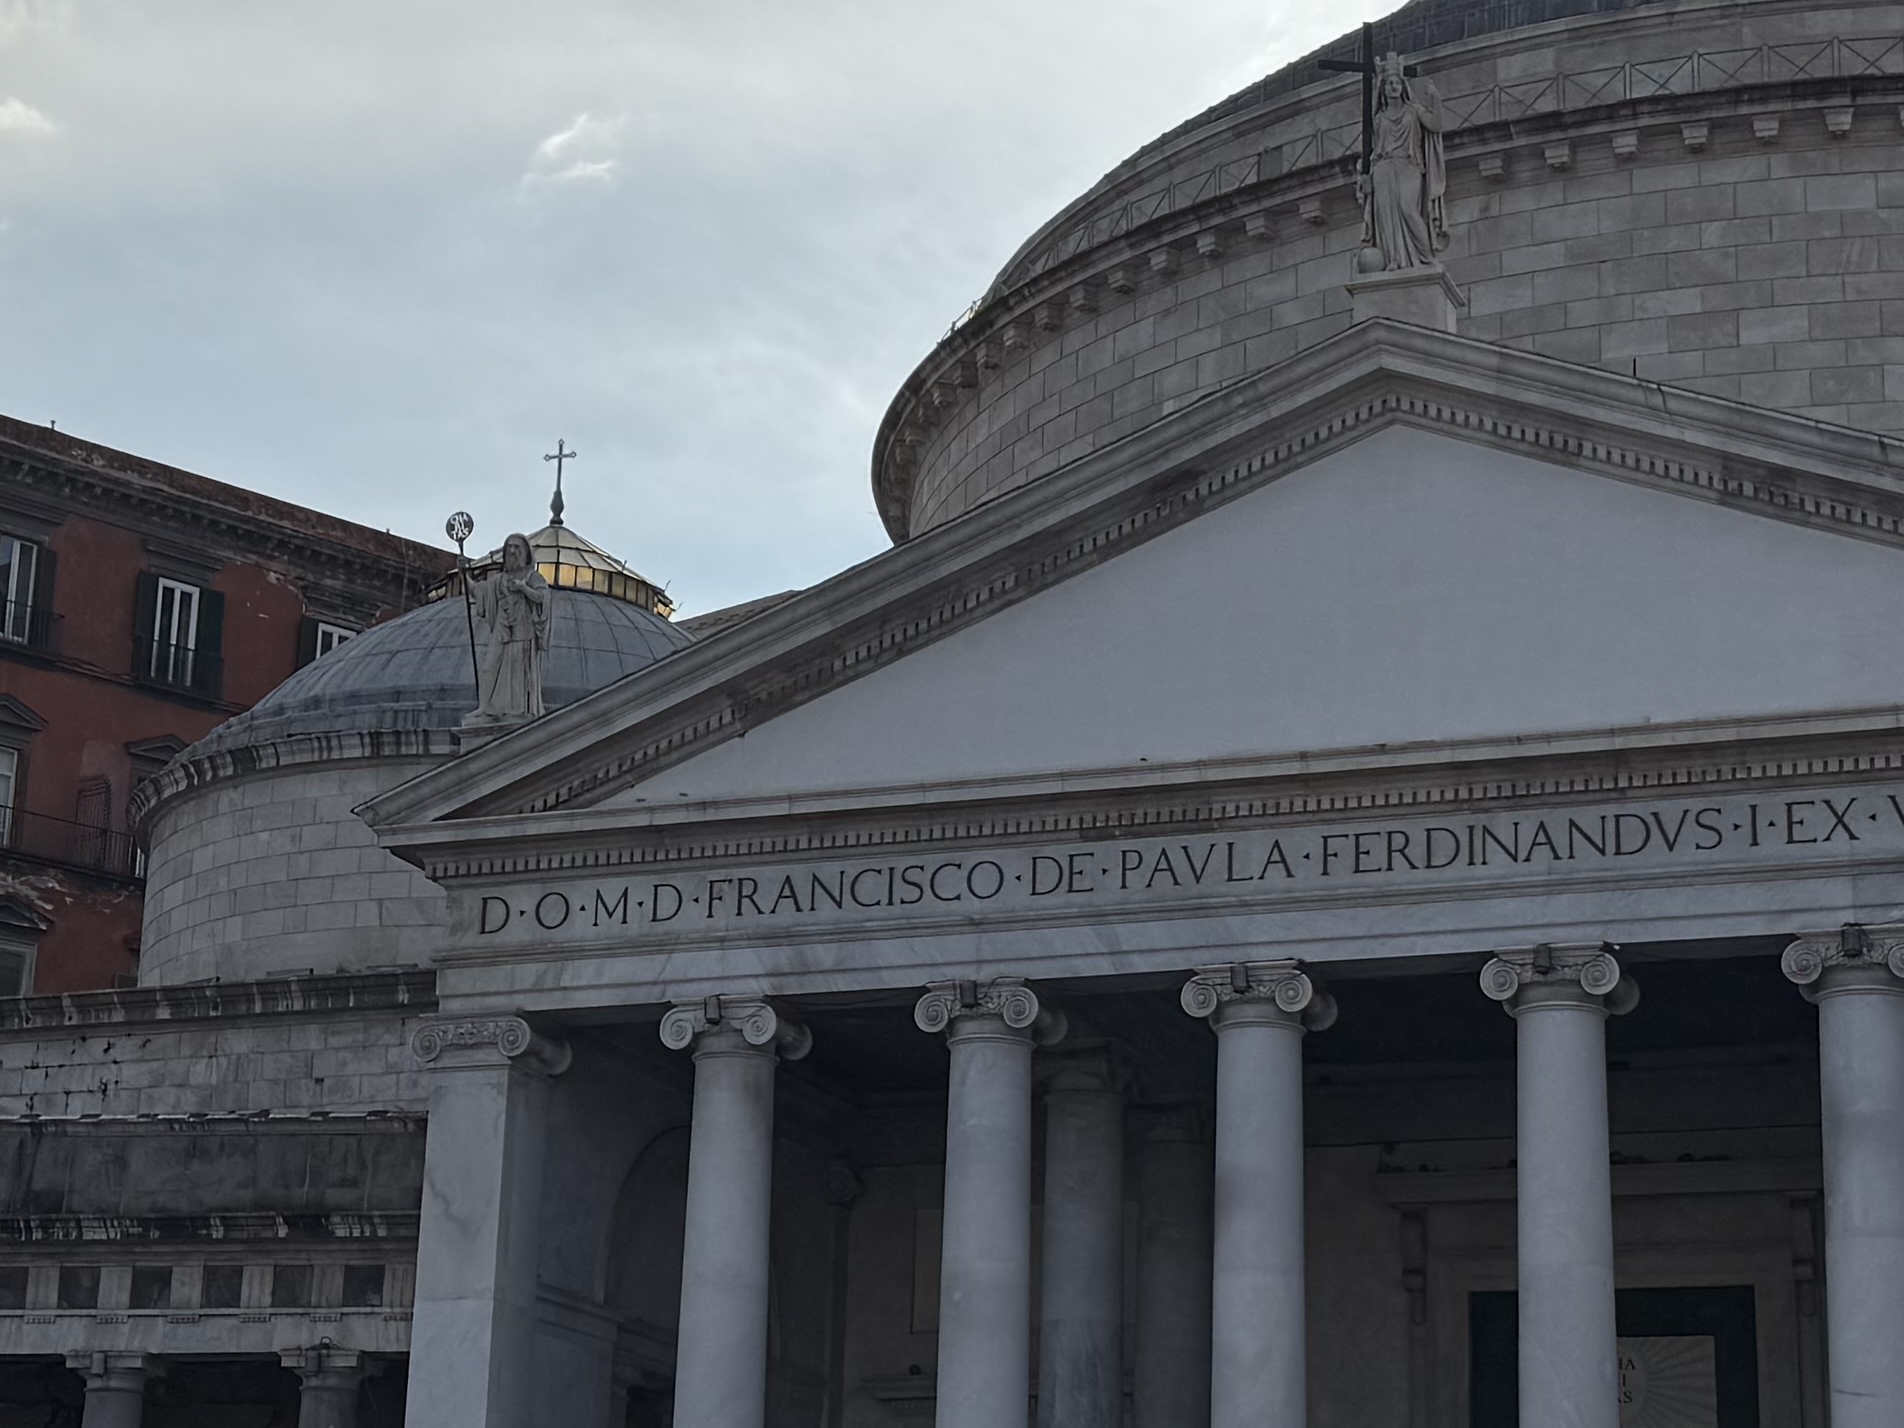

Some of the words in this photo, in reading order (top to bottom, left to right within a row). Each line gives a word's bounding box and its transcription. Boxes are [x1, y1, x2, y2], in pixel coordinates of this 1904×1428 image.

[705, 860, 1004, 920] FRANCISCO
[1029, 852, 1095, 897] DE
[1118, 838, 1296, 890] PAVLA
[1319, 806, 1723, 877] FERDINANDVS
[1784, 796, 1861, 846] EX
